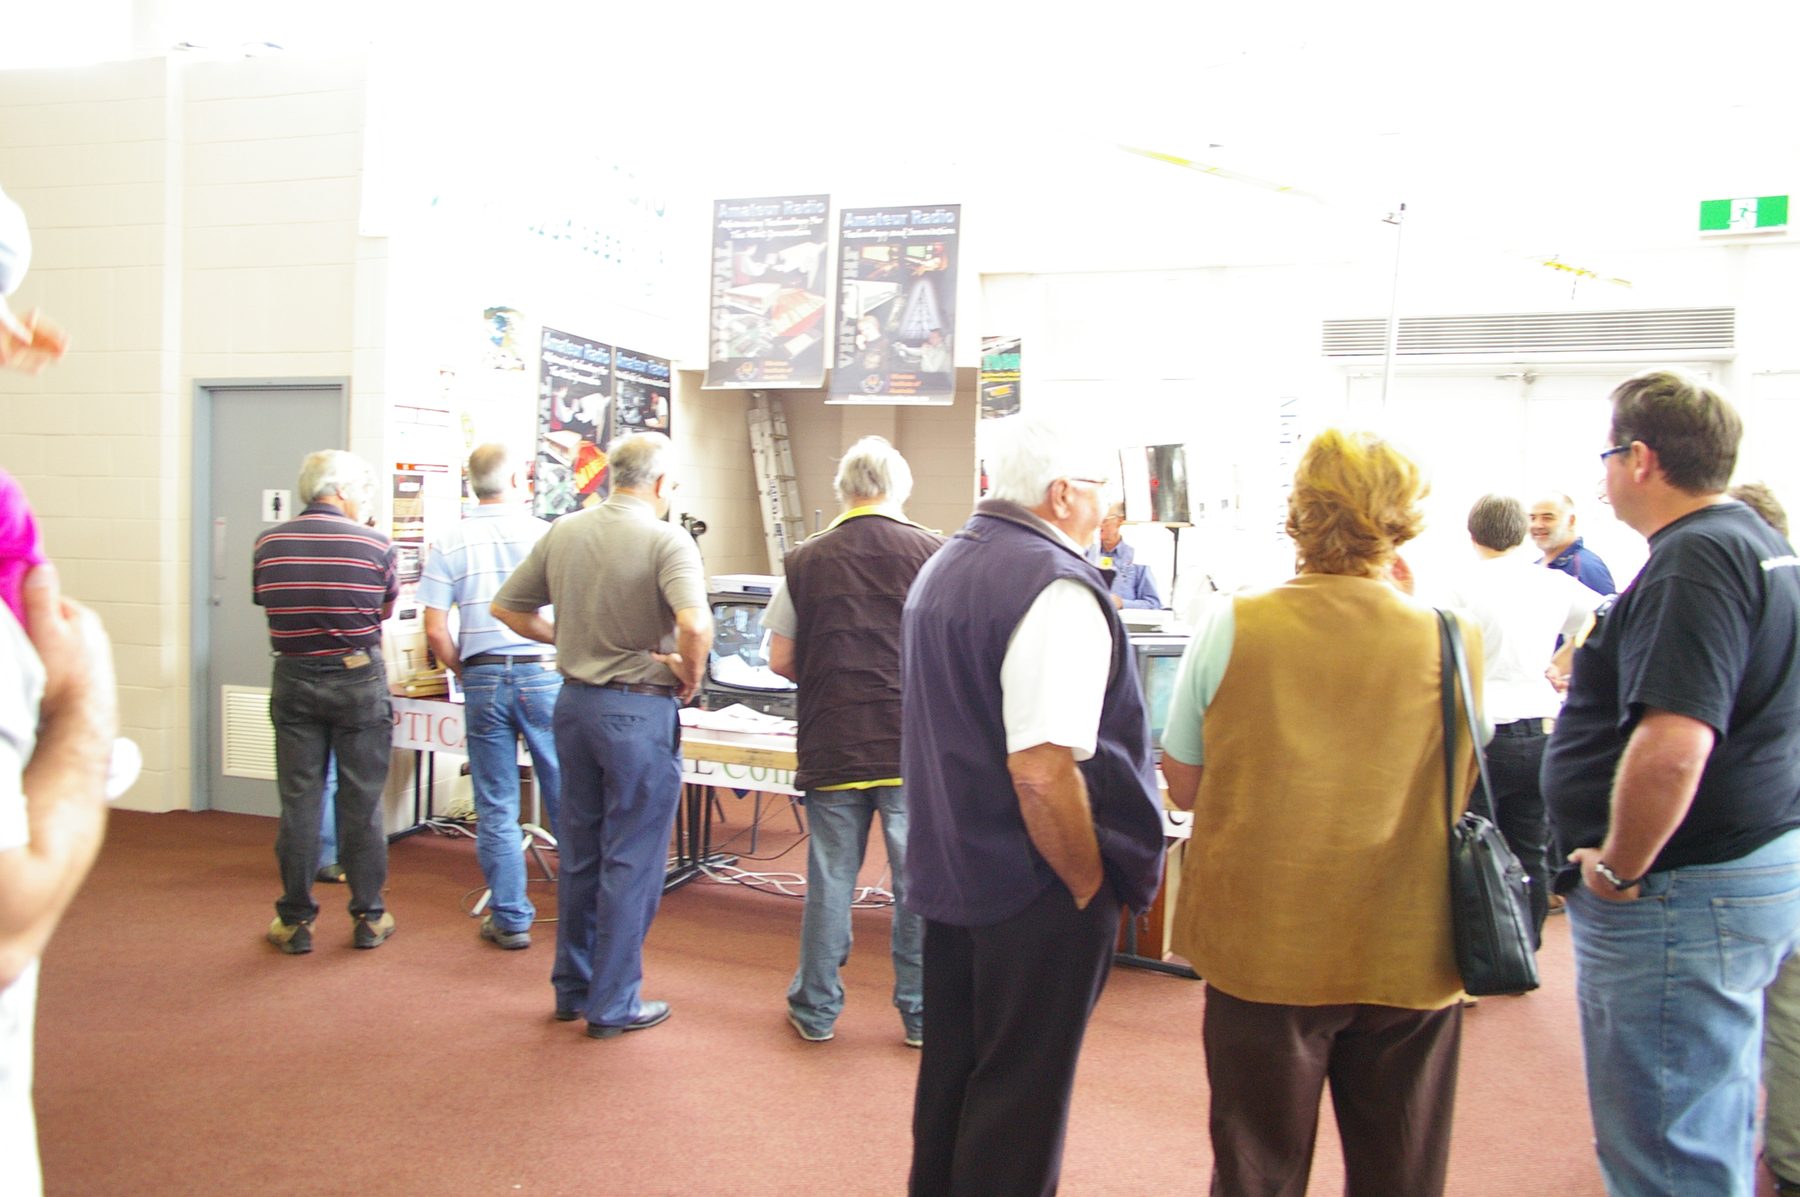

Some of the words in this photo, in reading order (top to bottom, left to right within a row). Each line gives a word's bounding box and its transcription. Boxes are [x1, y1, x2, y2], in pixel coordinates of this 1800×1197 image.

[718, 203, 781, 218] Amateur
[783, 199, 826, 216] Radio
[842, 212, 908, 227] Amateur
[910, 208, 955, 225] Radio
